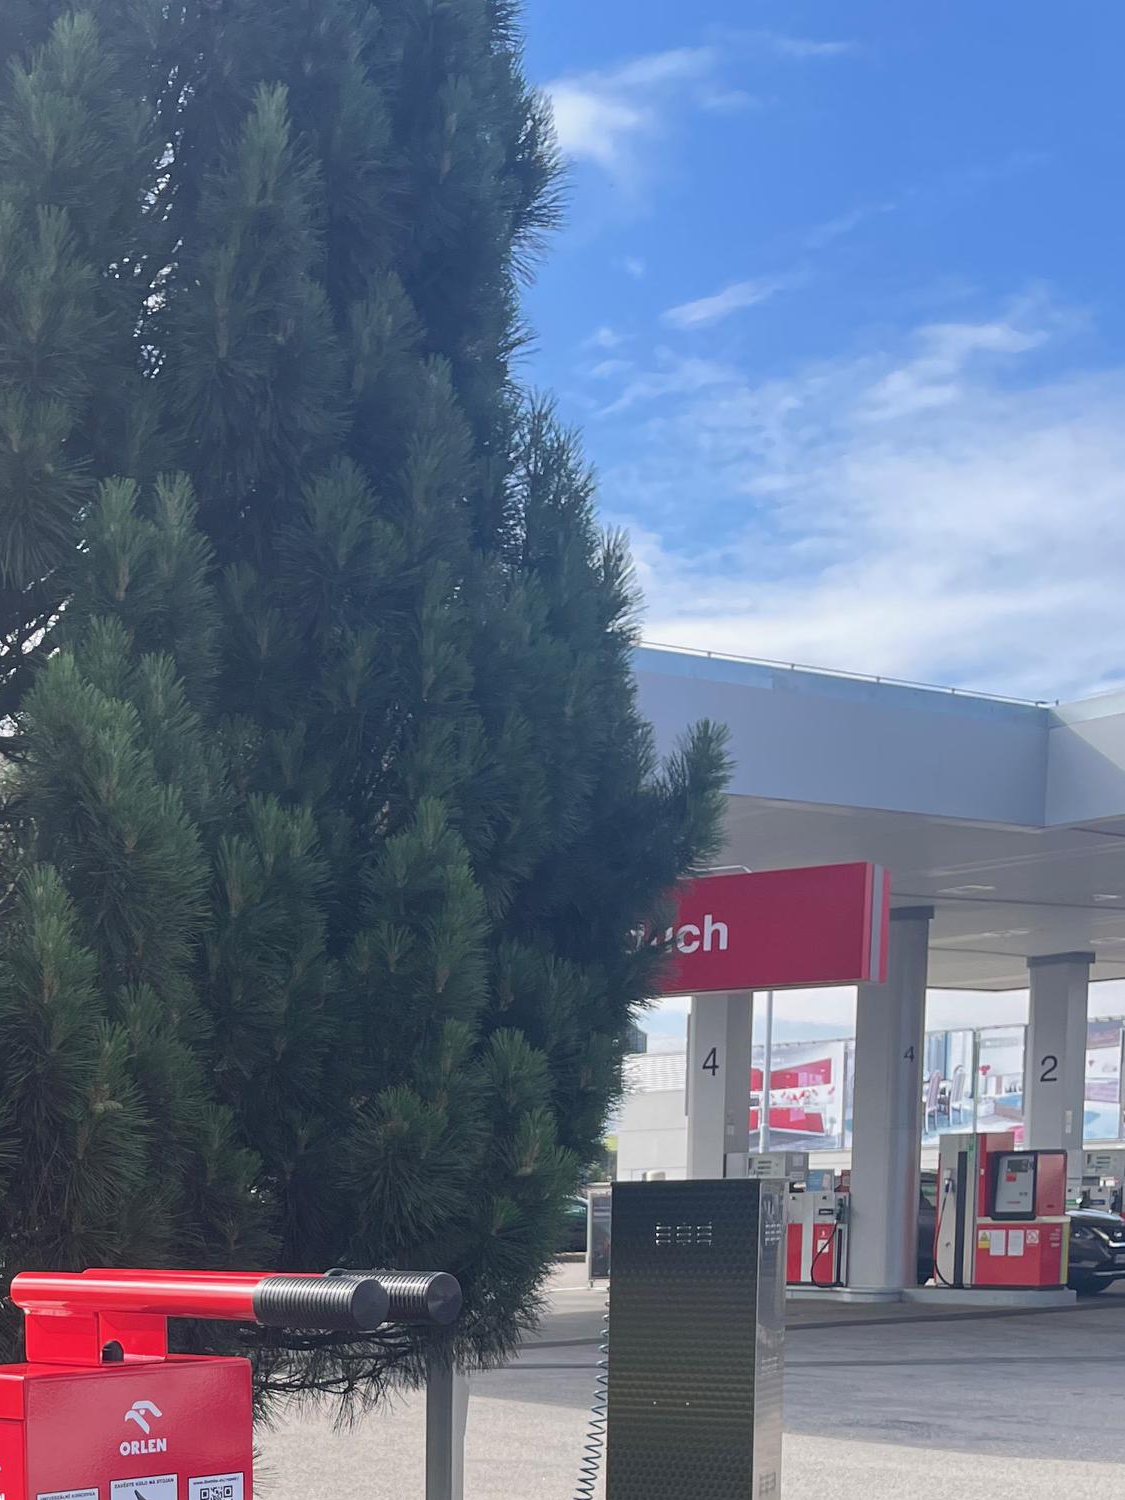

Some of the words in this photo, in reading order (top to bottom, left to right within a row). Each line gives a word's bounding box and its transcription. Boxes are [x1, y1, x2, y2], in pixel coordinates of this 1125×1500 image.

[702, 1046, 719, 1077] 4
[903, 1045, 915, 1063] 4
[1039, 1055, 1058, 1083] 2
[119, 1438, 167, 1456] ORLEN
